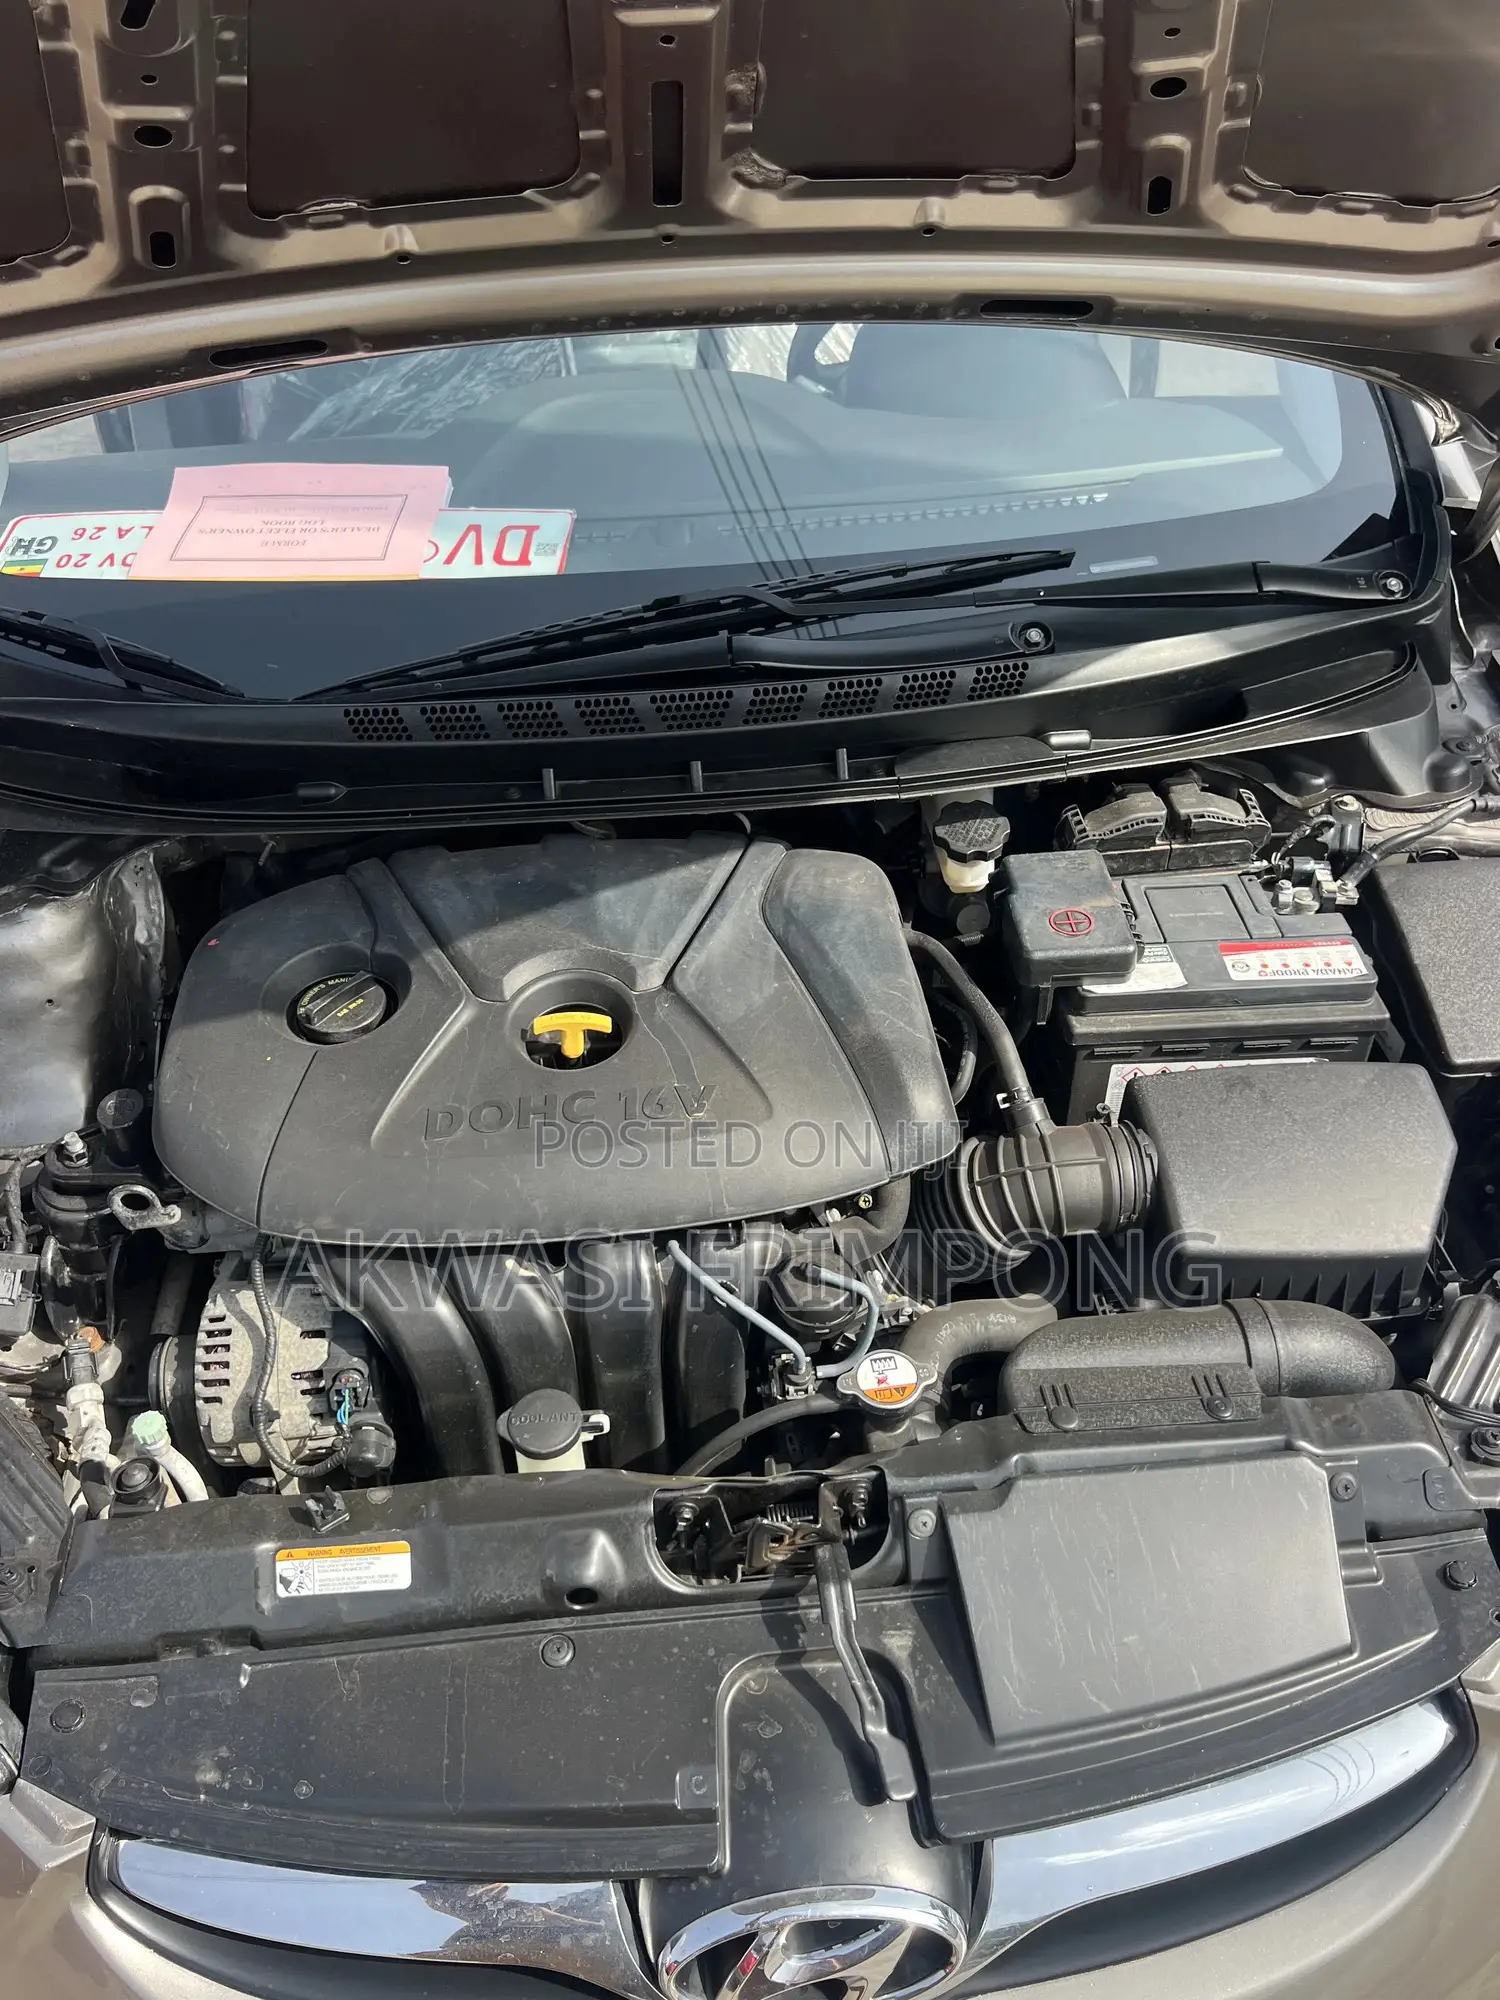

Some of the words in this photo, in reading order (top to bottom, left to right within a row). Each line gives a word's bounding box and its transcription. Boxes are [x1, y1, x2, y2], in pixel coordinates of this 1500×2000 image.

[260, 519, 297, 527] BOOK
[297, 519, 325, 527] LOG
[71, 526, 108, 542] 26
[197, 526, 256, 536] OWNER'S
[255, 527, 297, 535] FLEET
[299, 527, 317, 535] OR
[319, 526, 381, 535] DEALER'S
[11, 535, 59, 556] GH
[271, 539, 307, 548] FORM
[55, 552, 92, 569] 20
[1310, 967, 1363, 977] CANADA
[423, 1088, 597, 1142] DOHC
[616, 1083, 719, 1121] 16V
[510, 1412, 578, 1424] COOLANT
[339, 1546, 381, 1554] AVERTISSEMENT
